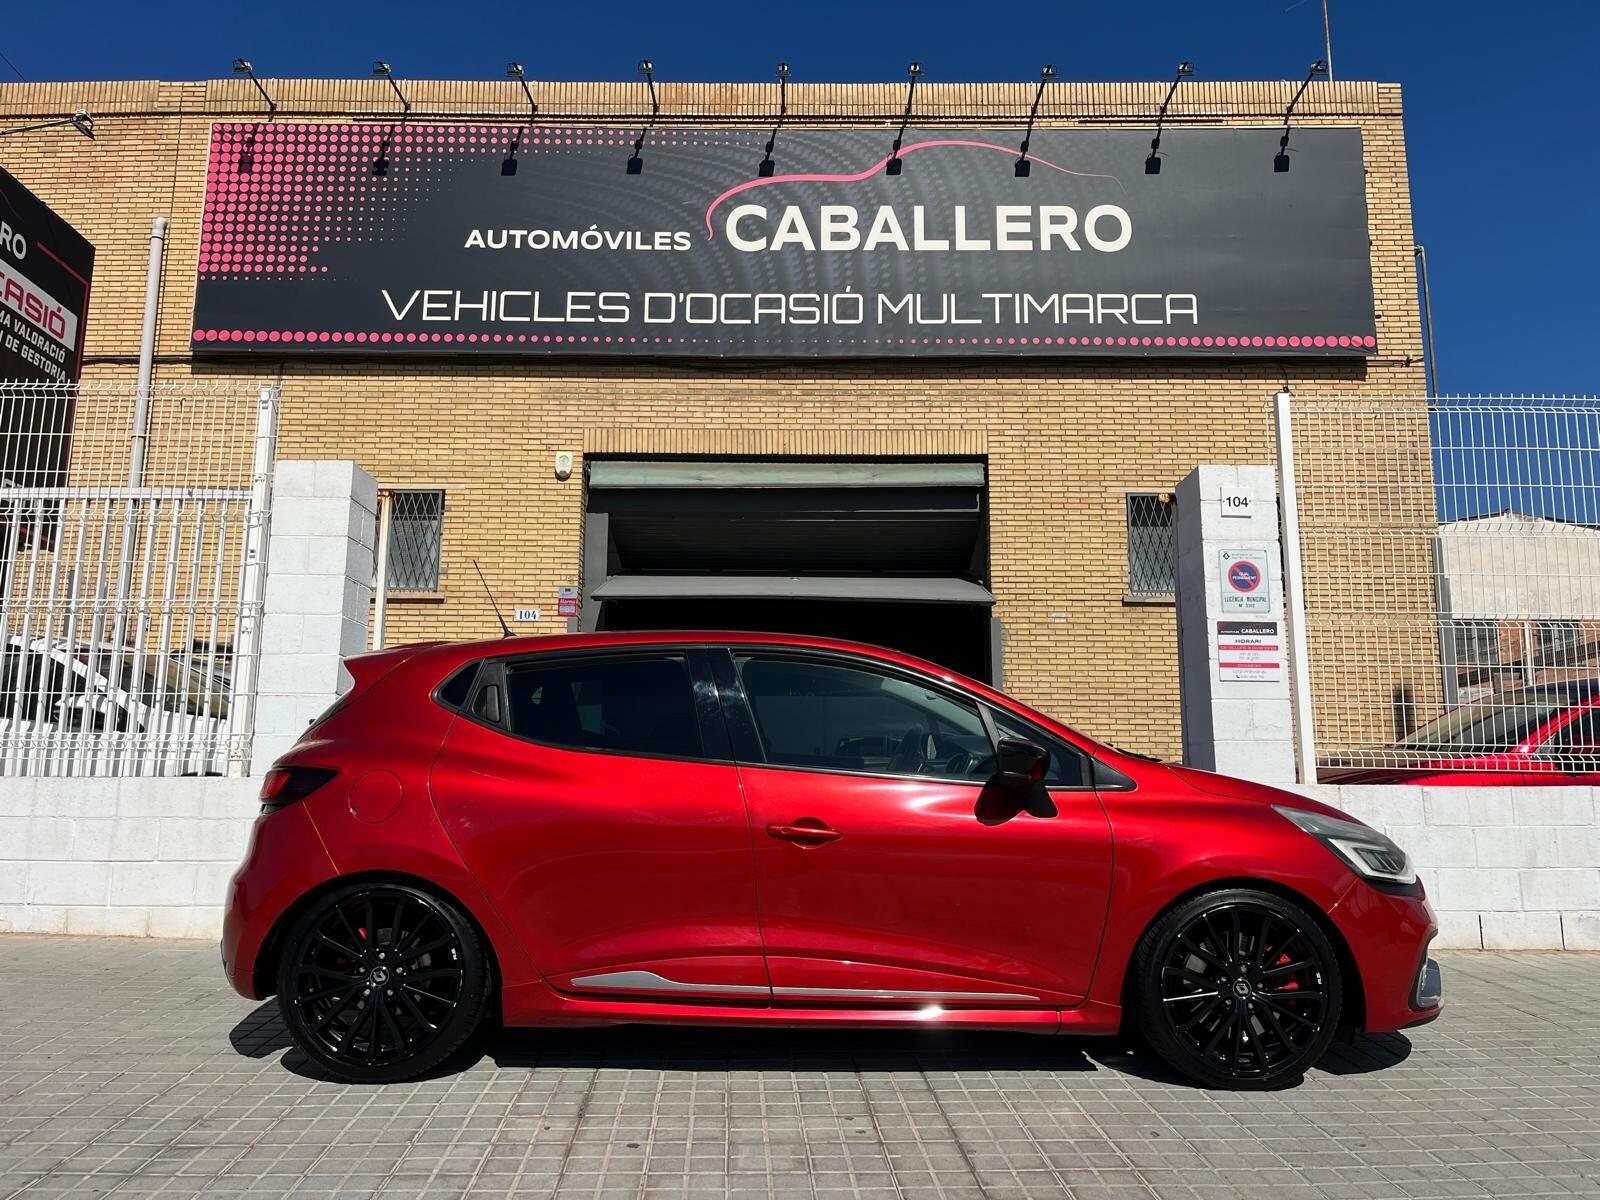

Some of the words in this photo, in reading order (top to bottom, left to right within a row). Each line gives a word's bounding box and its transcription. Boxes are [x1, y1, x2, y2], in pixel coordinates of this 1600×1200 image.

[464, 223, 692, 251] AUTOMÓVILES
[725, 204, 1133, 253] CABALLERO
[381, 289, 631, 324] VEHICLES
[643, 285, 864, 325] D'OCASIÓ
[877, 293, 1199, 326] MULTIMARCA
[5, 334, 20, 352] DE
[21, 344, 66, 383] GESTORIA
[14, 318, 66, 363] VALORACIÓ
[1225, 496, 1249, 508] 104
[519, 610, 537, 620] 104
